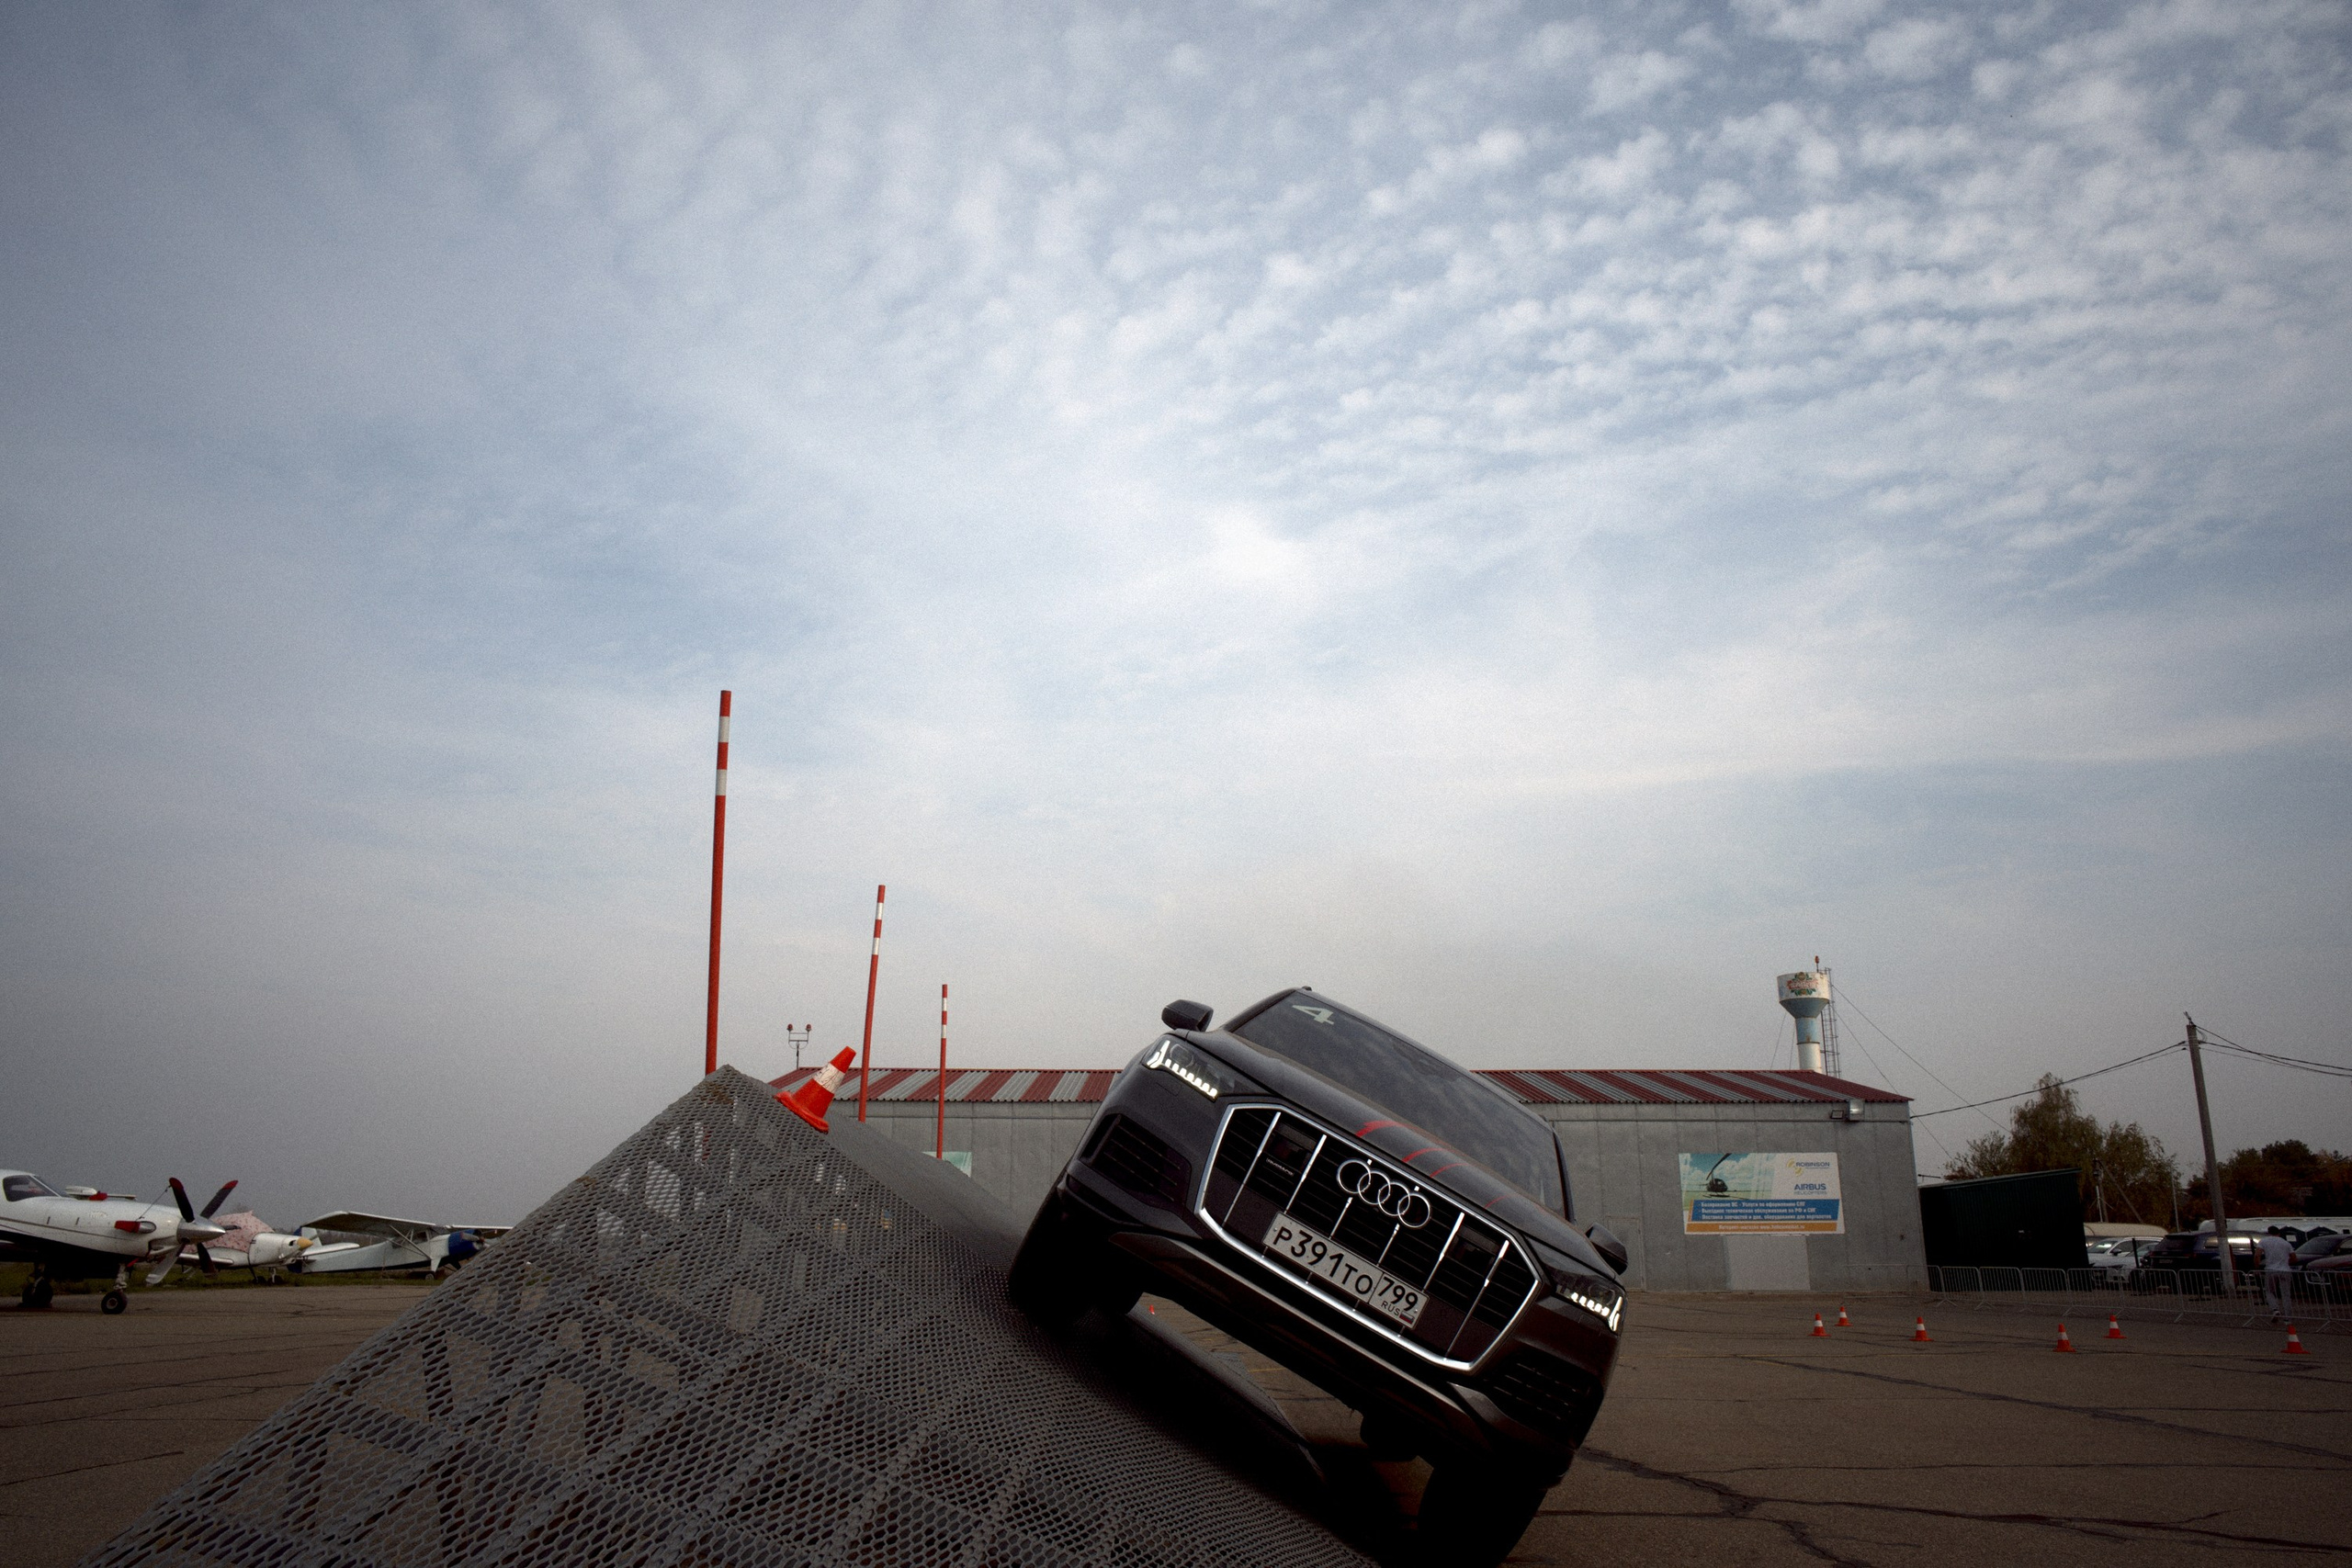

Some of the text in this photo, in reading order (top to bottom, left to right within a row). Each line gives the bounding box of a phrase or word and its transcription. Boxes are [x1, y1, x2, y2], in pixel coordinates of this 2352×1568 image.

[1292, 1003, 1335, 1026] 4
[1377, 1276, 1419, 1311] 799
[1380, 1300, 1401, 1316] RUS
